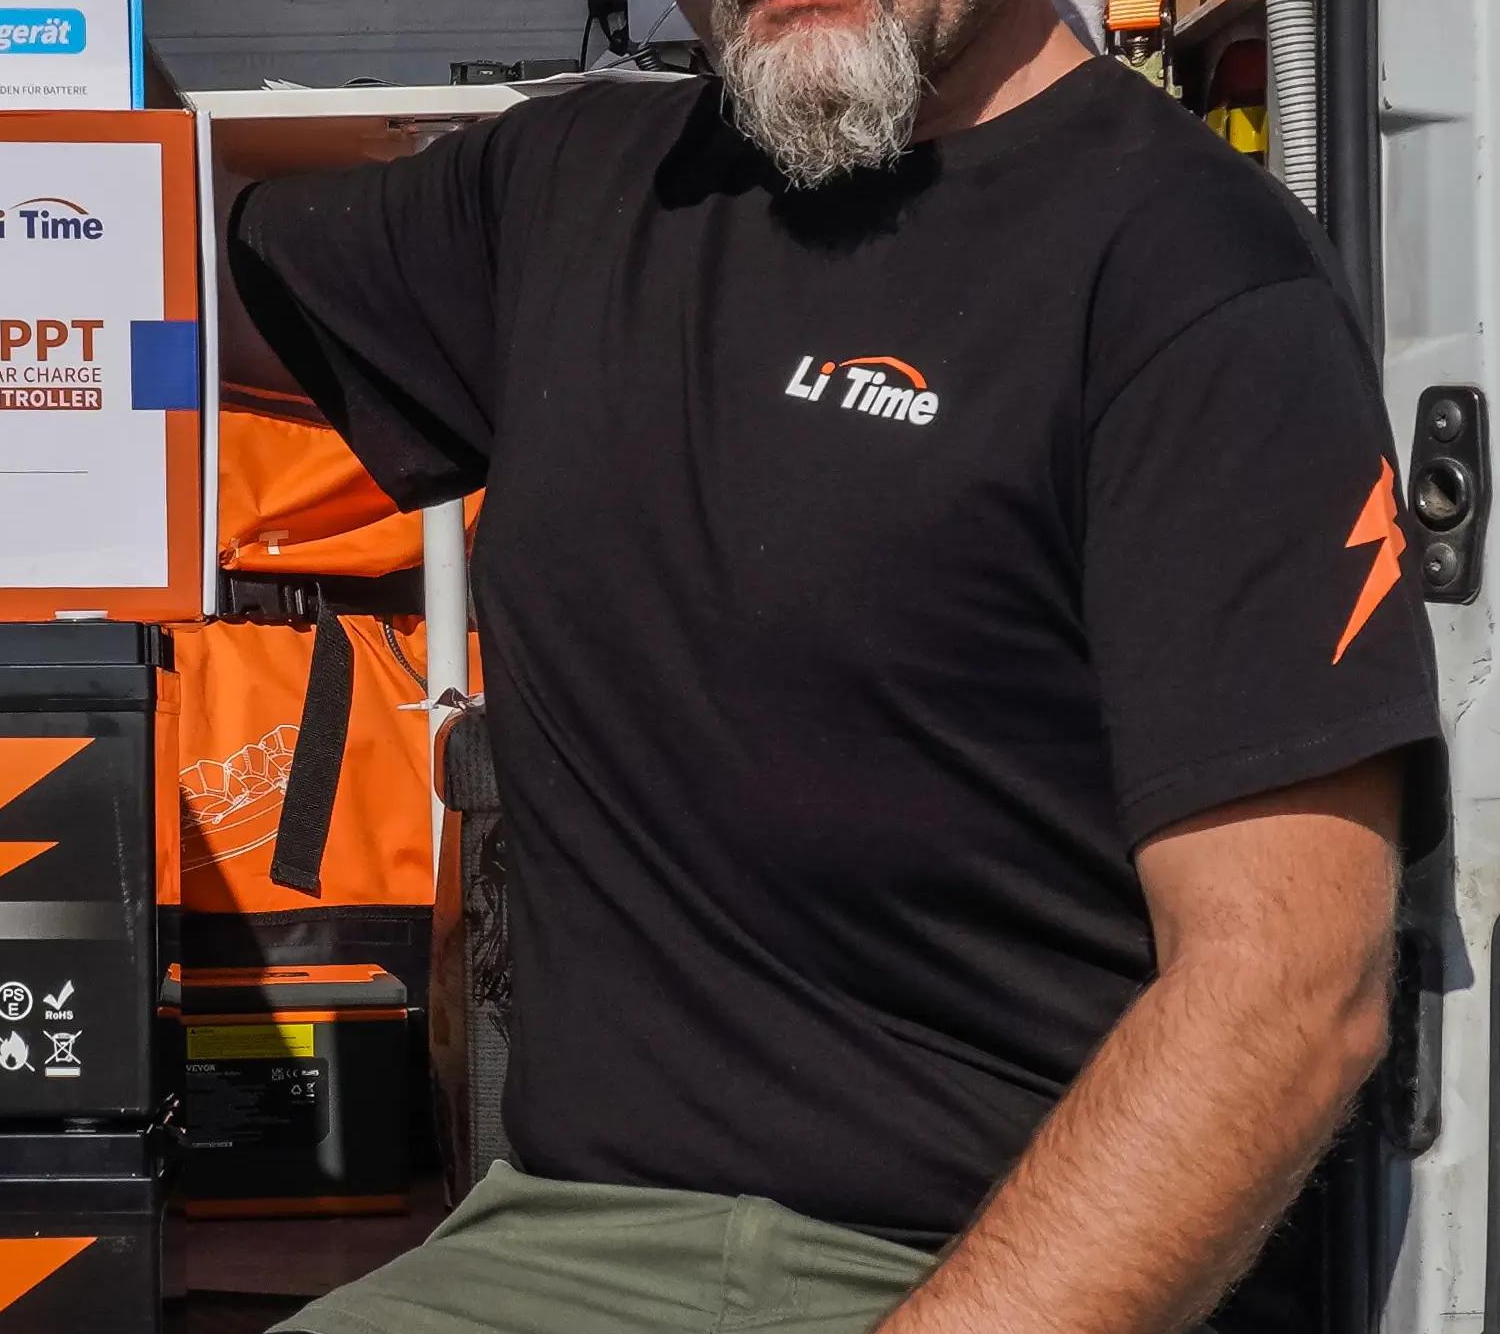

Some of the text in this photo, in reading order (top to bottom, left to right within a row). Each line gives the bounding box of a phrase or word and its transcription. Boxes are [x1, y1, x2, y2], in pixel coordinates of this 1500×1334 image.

[22, 84, 41, 96] FÜR
[43, 85, 88, 96] BATTERIE
[19, 210, 104, 240] Time
[22, 367, 102, 384] CHARGE
[785, 355, 939, 425] Li Time
[45, 1010, 74, 1020] RoHS
